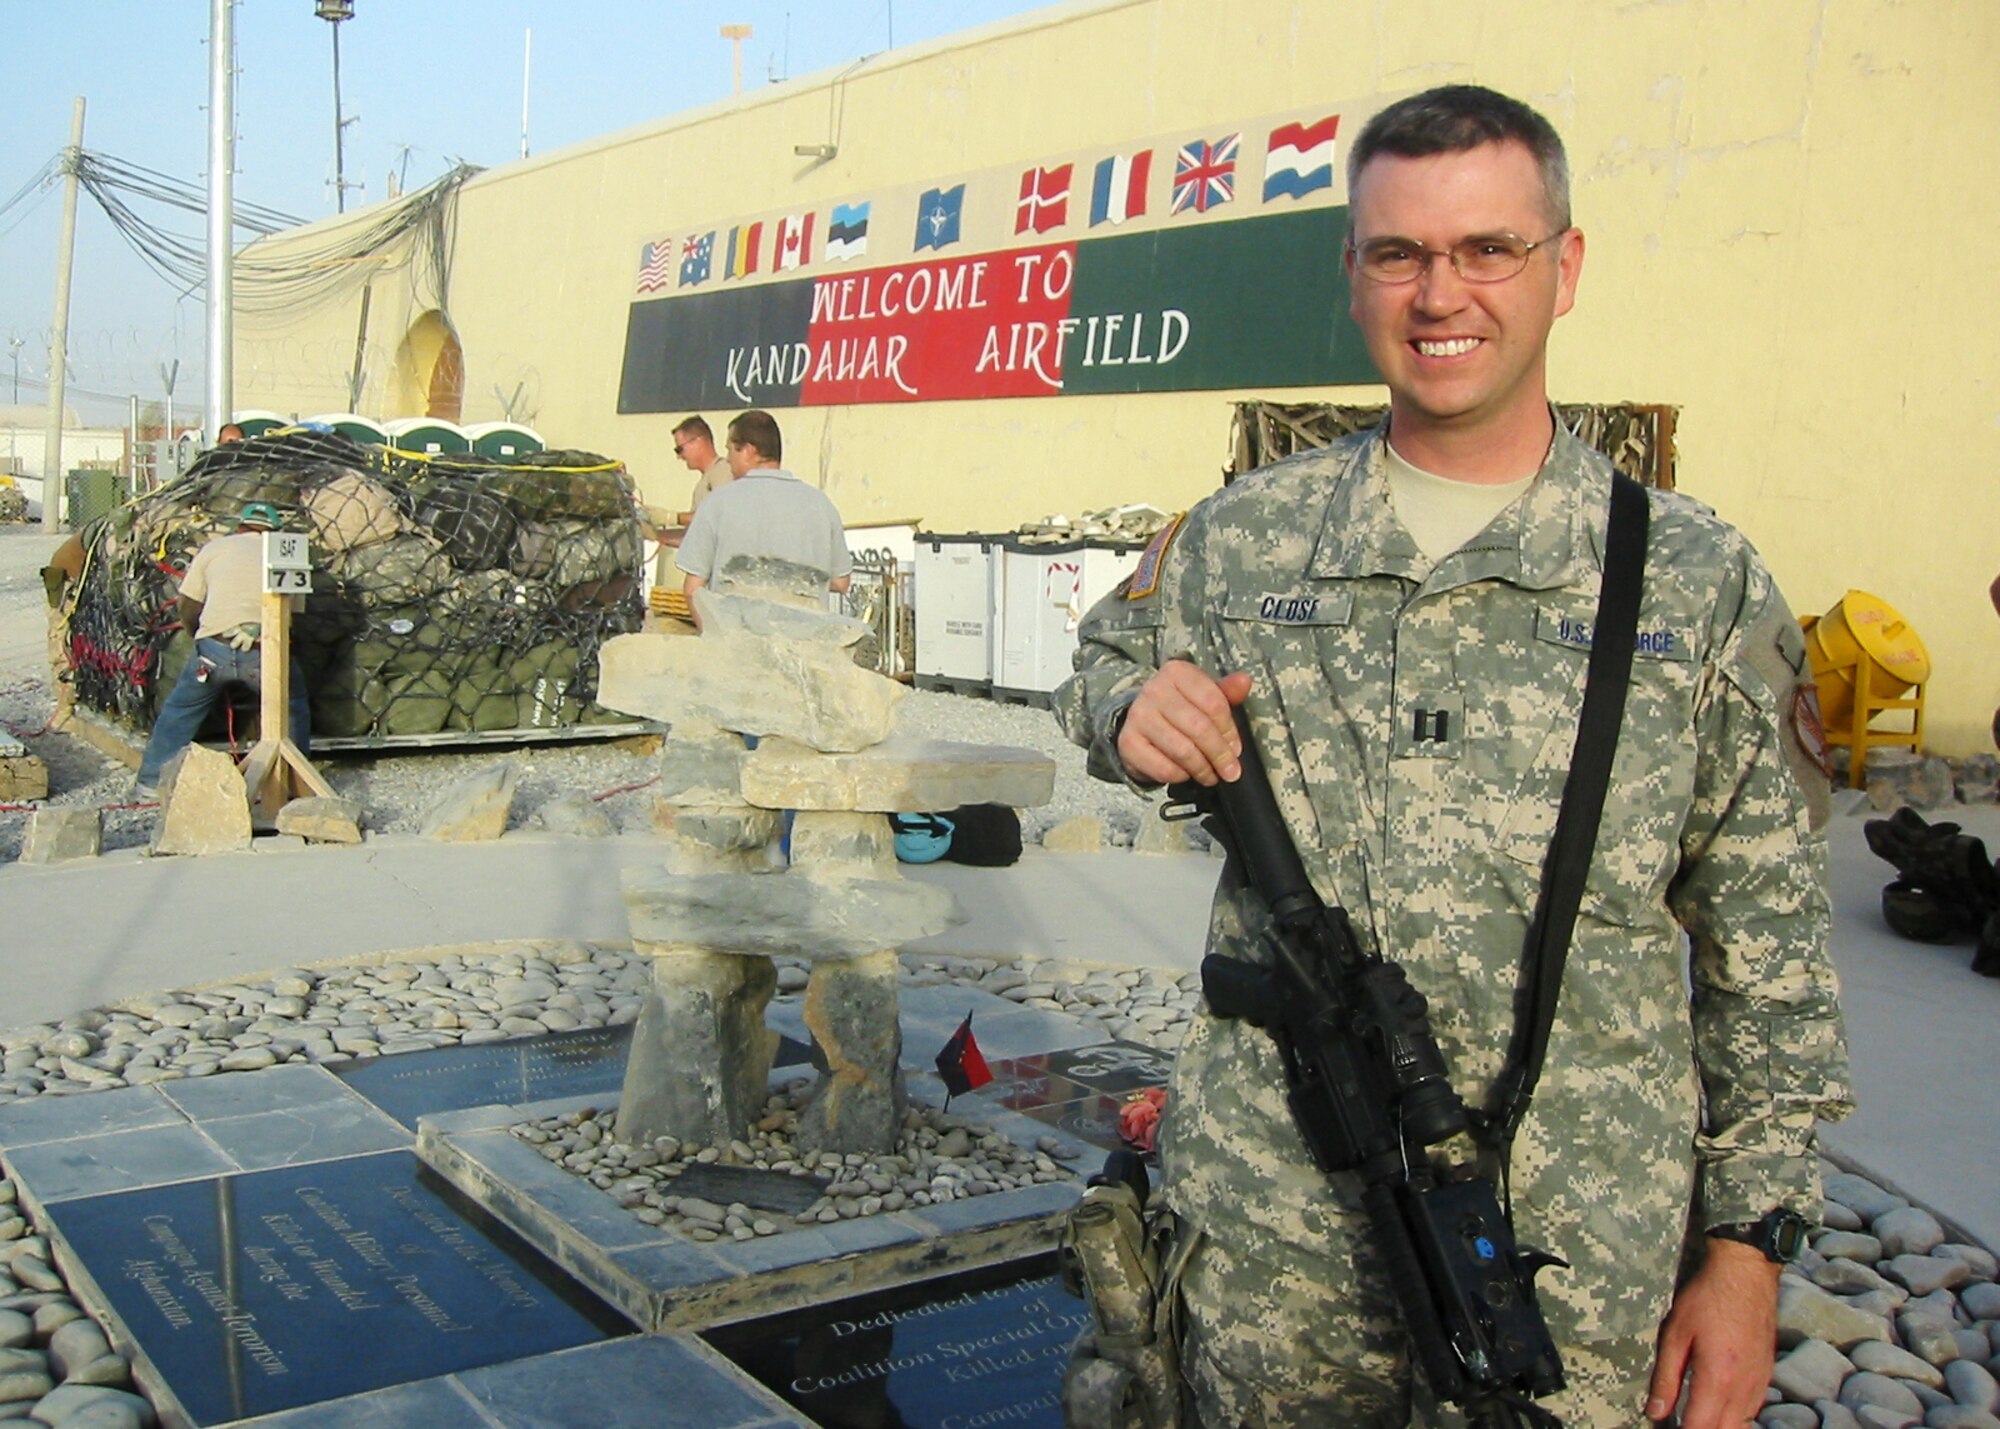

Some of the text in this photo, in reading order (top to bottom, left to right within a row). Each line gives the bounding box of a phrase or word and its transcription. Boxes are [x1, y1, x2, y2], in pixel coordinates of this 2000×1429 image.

[809, 249, 1073, 324] WELCOME TO
[725, 310, 1190, 403] KANDAHAR AIRFIELD
[272, 570, 307, 588] 73
[830, 1278, 1055, 1337] Dedicated to the
[1022, 1296, 1050, 1314] of
[790, 1353, 936, 1394] Coalition
[936, 1321, 1045, 1358] Special
[945, 1349, 1036, 1383] Killed
[940, 1390, 1060, 1429] Campai
